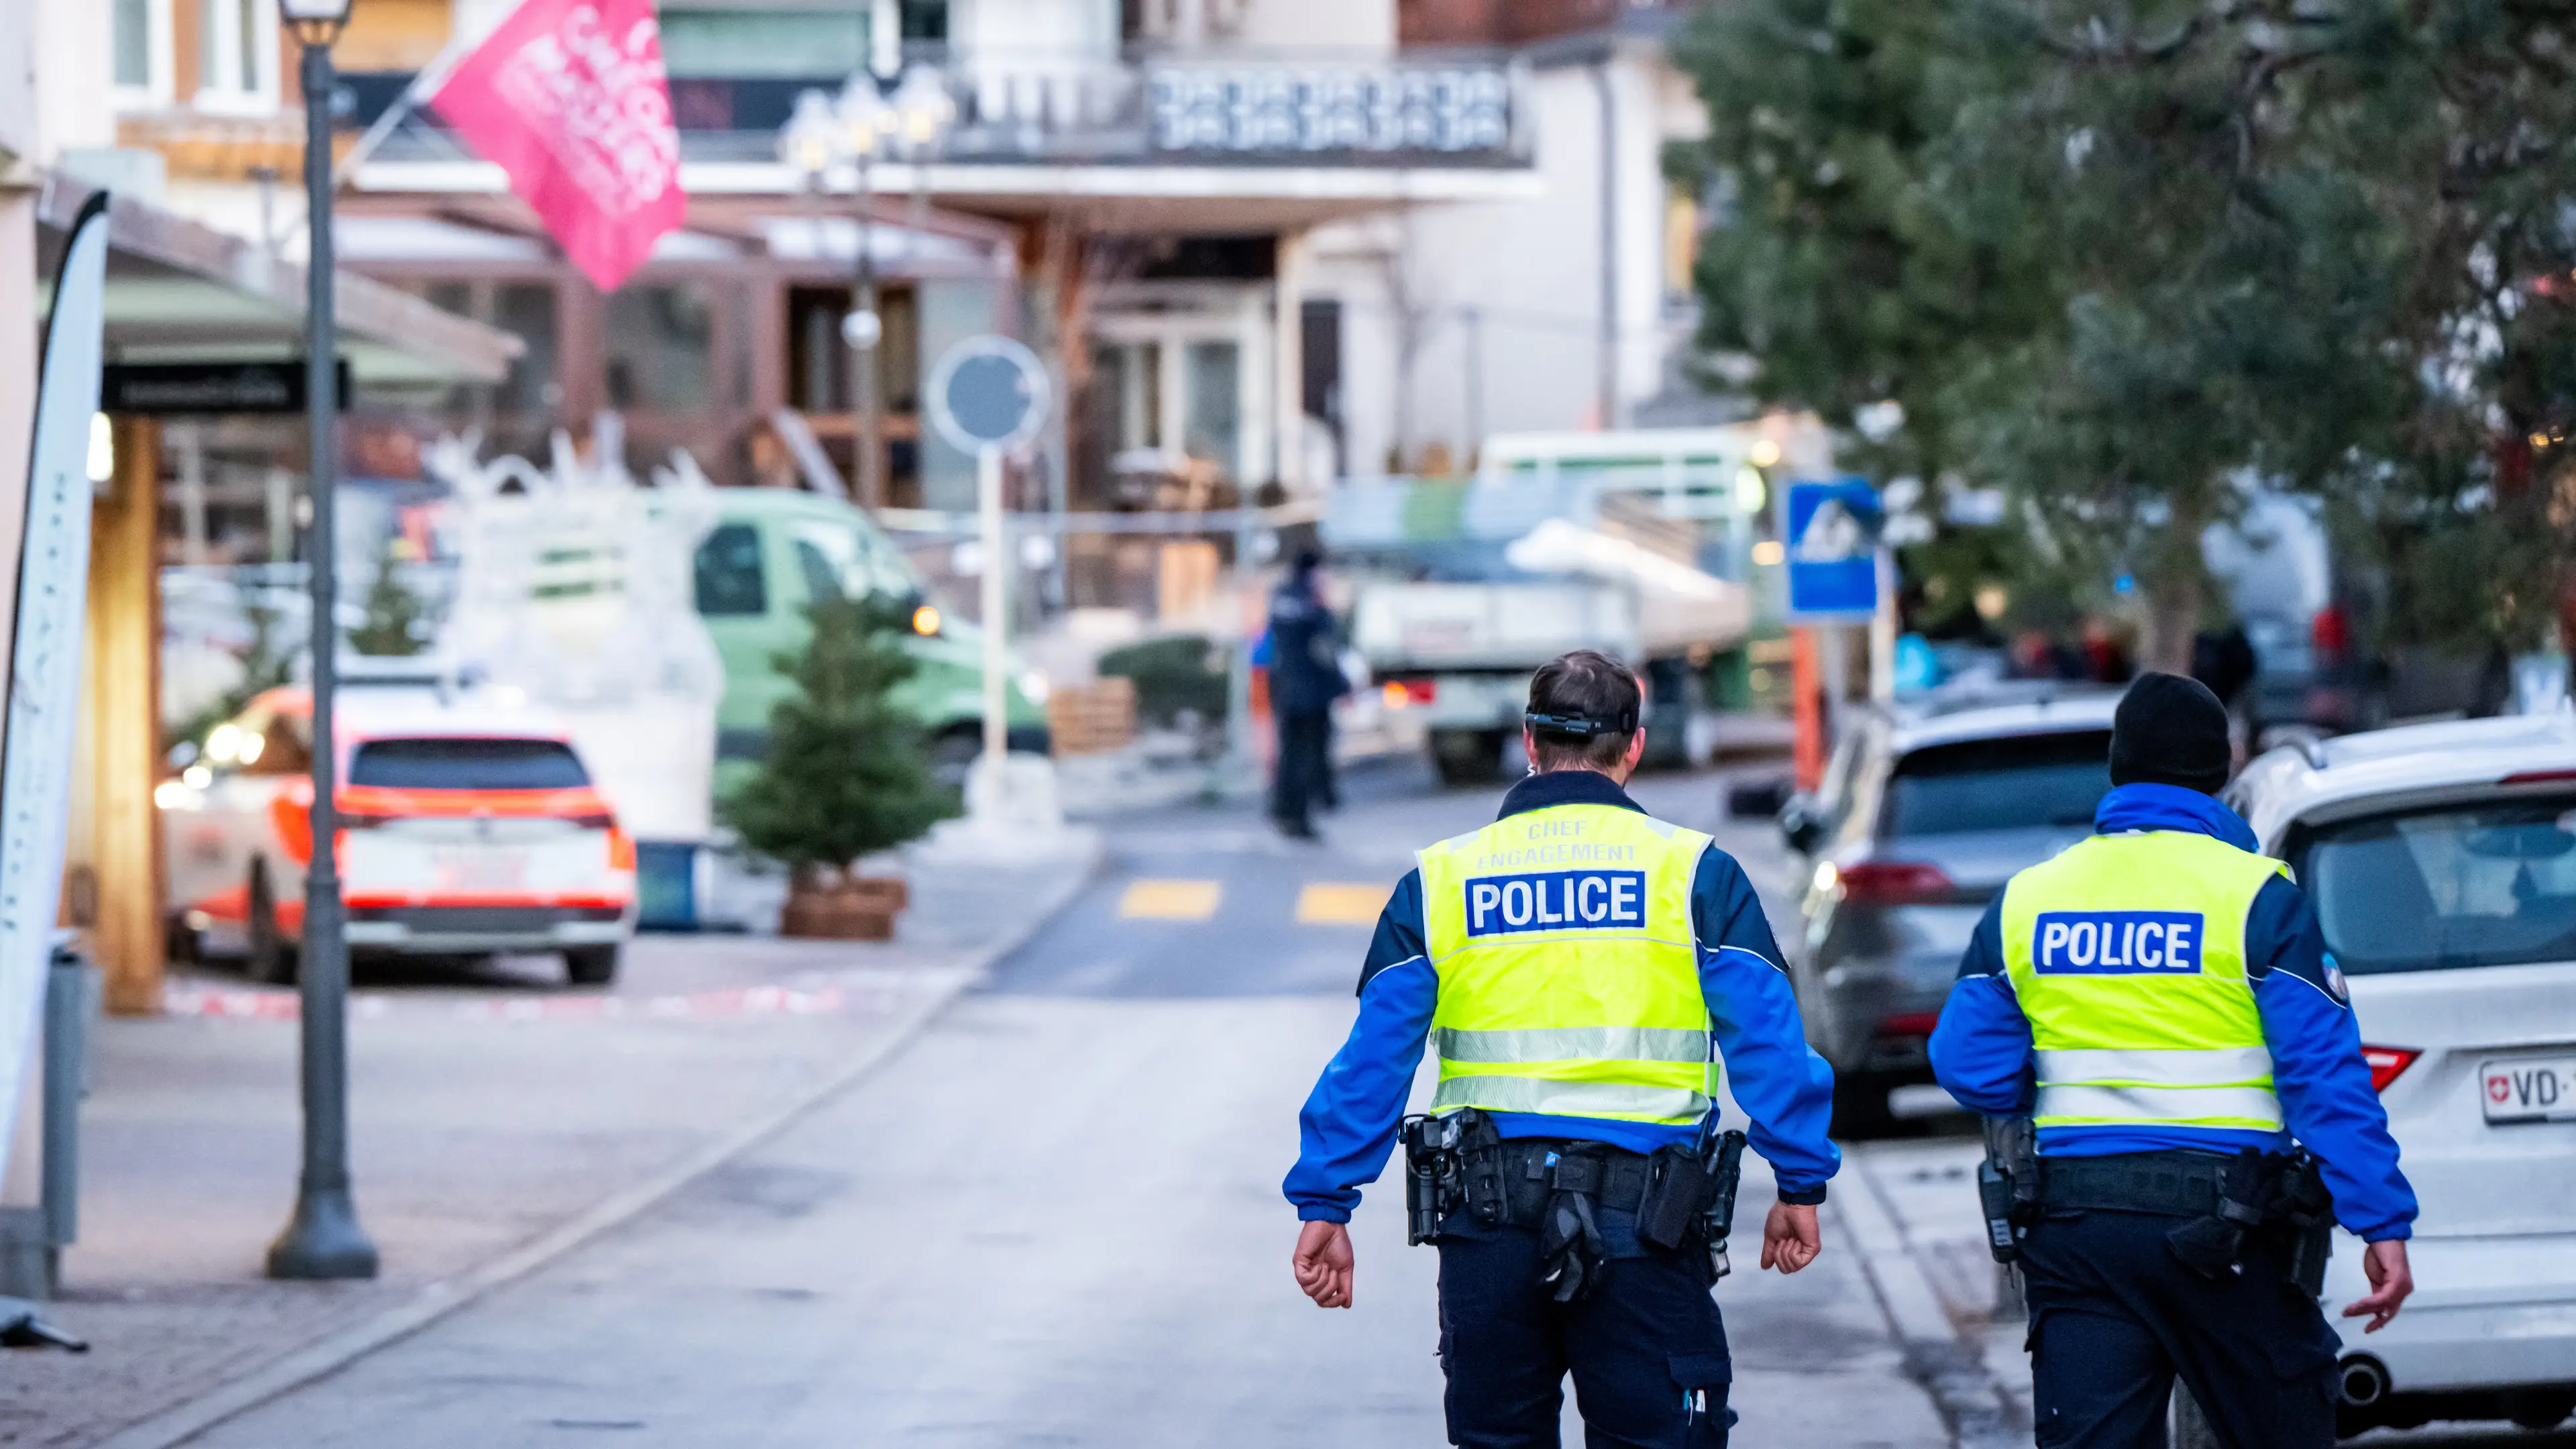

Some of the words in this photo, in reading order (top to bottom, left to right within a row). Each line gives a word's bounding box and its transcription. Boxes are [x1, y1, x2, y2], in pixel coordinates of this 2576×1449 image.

[1528, 820, 1587, 840] CHEF
[1477, 844, 1637, 869] ENGAGEMENT
[1472, 876, 1638, 928] POLICE
[2042, 921, 2192, 968] POLICE
